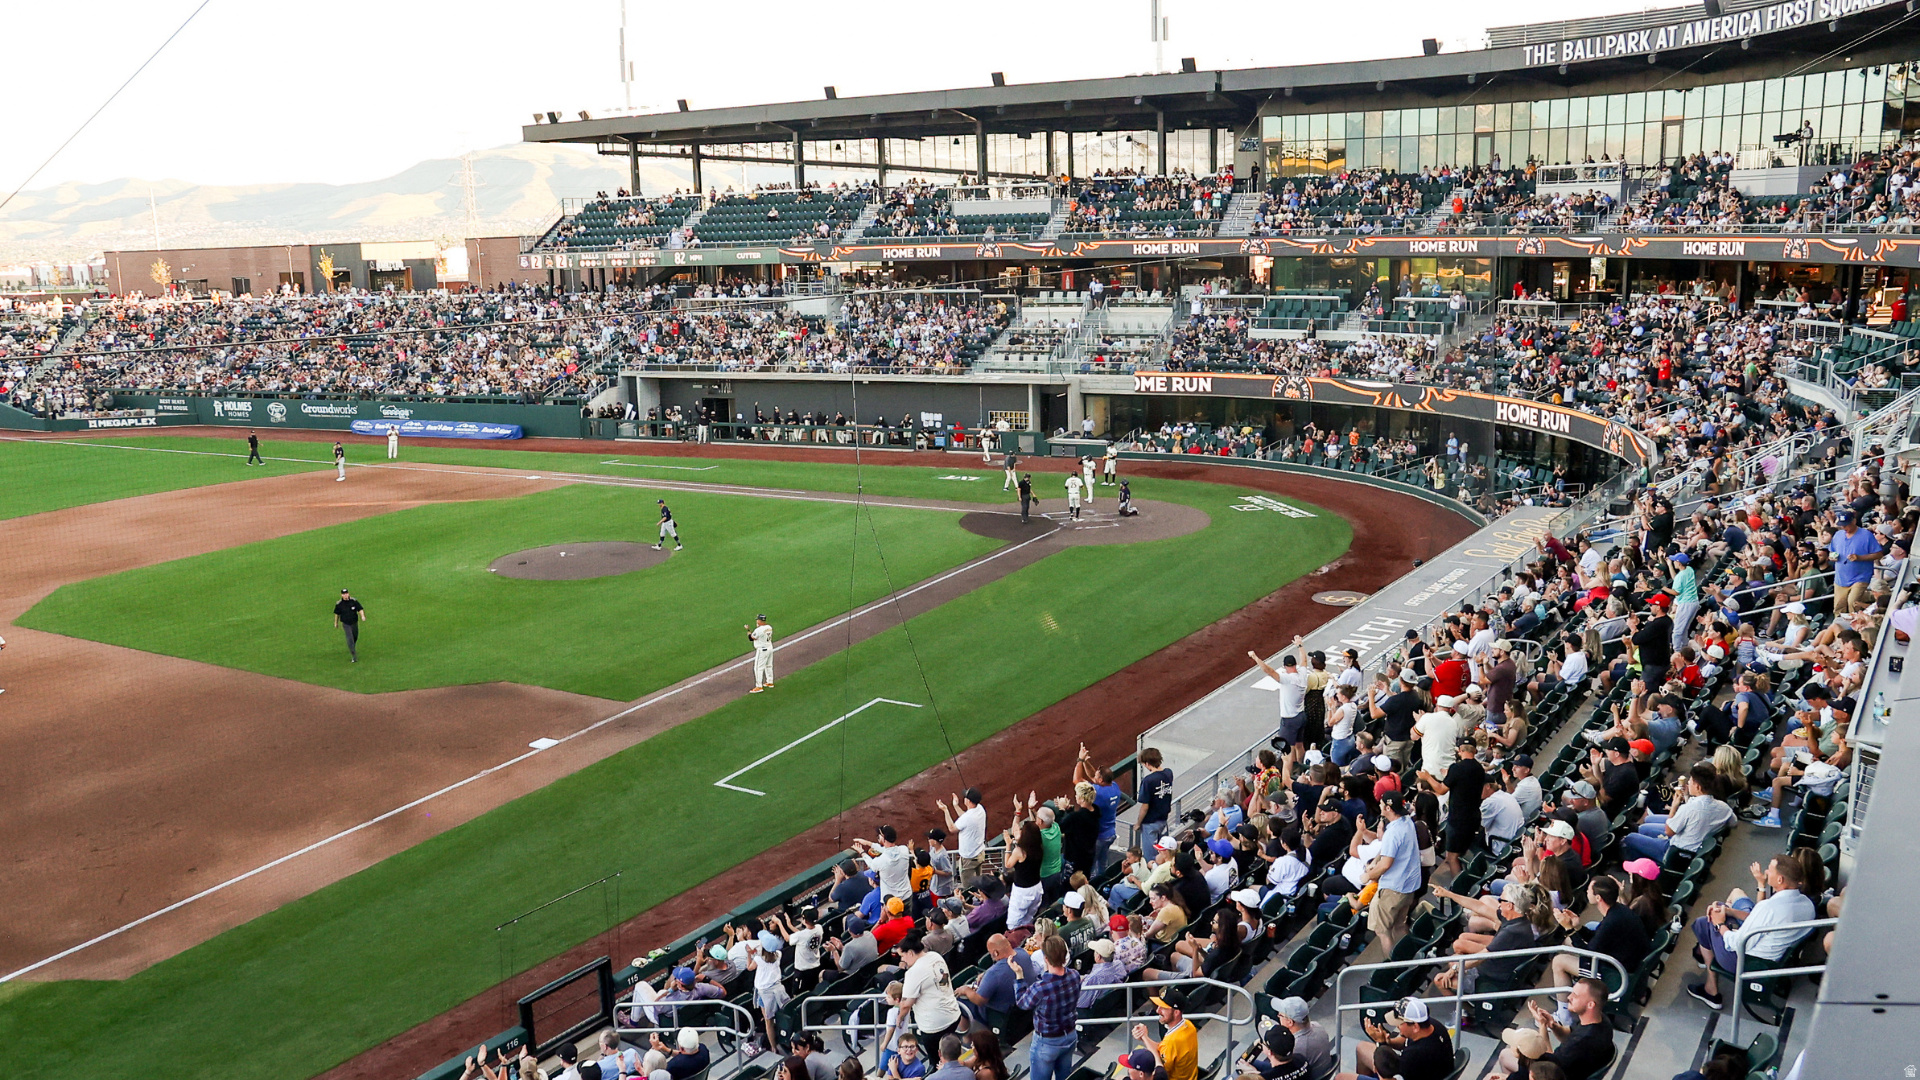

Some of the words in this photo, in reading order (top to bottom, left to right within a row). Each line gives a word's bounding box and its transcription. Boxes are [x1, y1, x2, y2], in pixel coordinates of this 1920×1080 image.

[1523, 43, 1557, 66] THE
[1562, 30, 1652, 62] BALLPARK
[1656, 25, 1680, 50] AT
[1681, 10, 1762, 45] AMERICA
[1766, 0, 1815, 31] FIRST
[1819, 0, 1884, 19] SQUA
[882, 248, 915, 259] HOME
[916, 247, 941, 258] RUN
[1133, 244, 1169, 255] HOME
[1171, 243, 1200, 254] RUN
[1409, 241, 1446, 253] HOME
[1449, 241, 1478, 252] RUN
[1683, 241, 1717, 255] HOME
[1718, 241, 1745, 256] RUN
[674, 252, 686, 265] 82
[736, 252, 761, 260] CUTTER
[1172, 376, 1212, 392] RUN
[223, 401, 253, 411] HOLMES
[301, 402, 357, 414] Groundworks
[98, 417, 157, 427] MEGAPLEX
[1496, 401, 1539, 427] HOME
[1540, 409, 1571, 433] RUN
[627, 973, 639, 986] 115
[506, 1038, 519, 1051] 116
